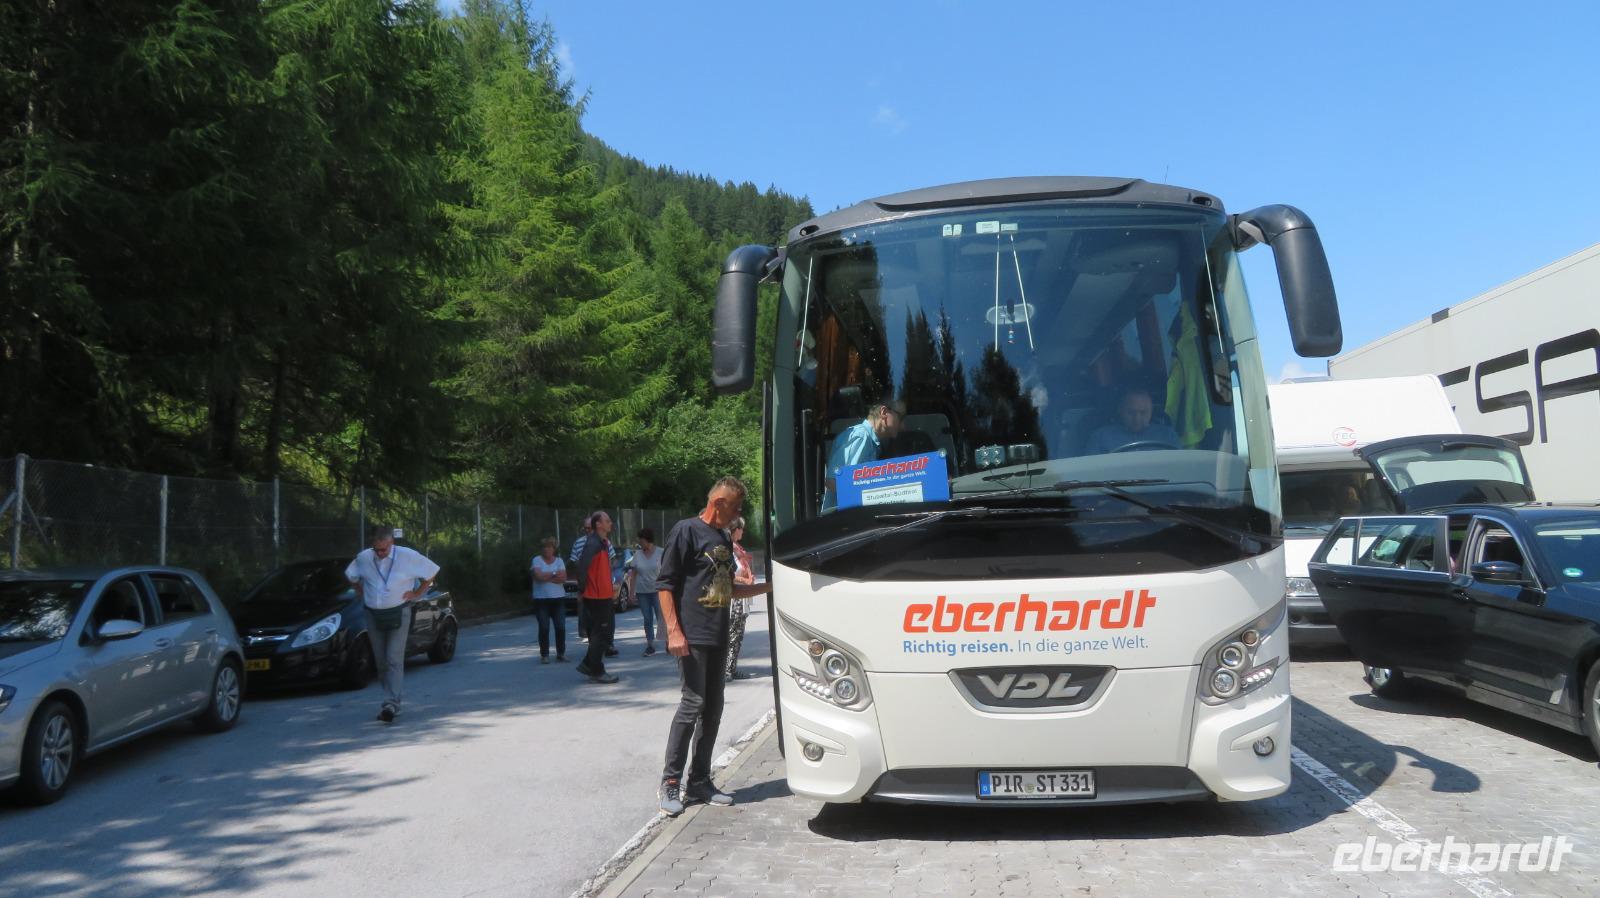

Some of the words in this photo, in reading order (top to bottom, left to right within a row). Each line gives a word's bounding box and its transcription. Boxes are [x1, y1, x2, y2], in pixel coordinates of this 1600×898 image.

[853, 456, 928, 480] eberhardt
[903, 589, 1157, 633] eberhardt
[903, 640, 956, 656] Richtig
[961, 640, 1014, 653] reisen.
[1018, 639, 1031, 652] In
[1036, 638, 1059, 652] die
[1064, 640, 1109, 655] ganze
[1112, 636, 1149, 650] Welt.
[976, 672, 1084, 699] VDL
[992, 775, 1024, 792] PIR
